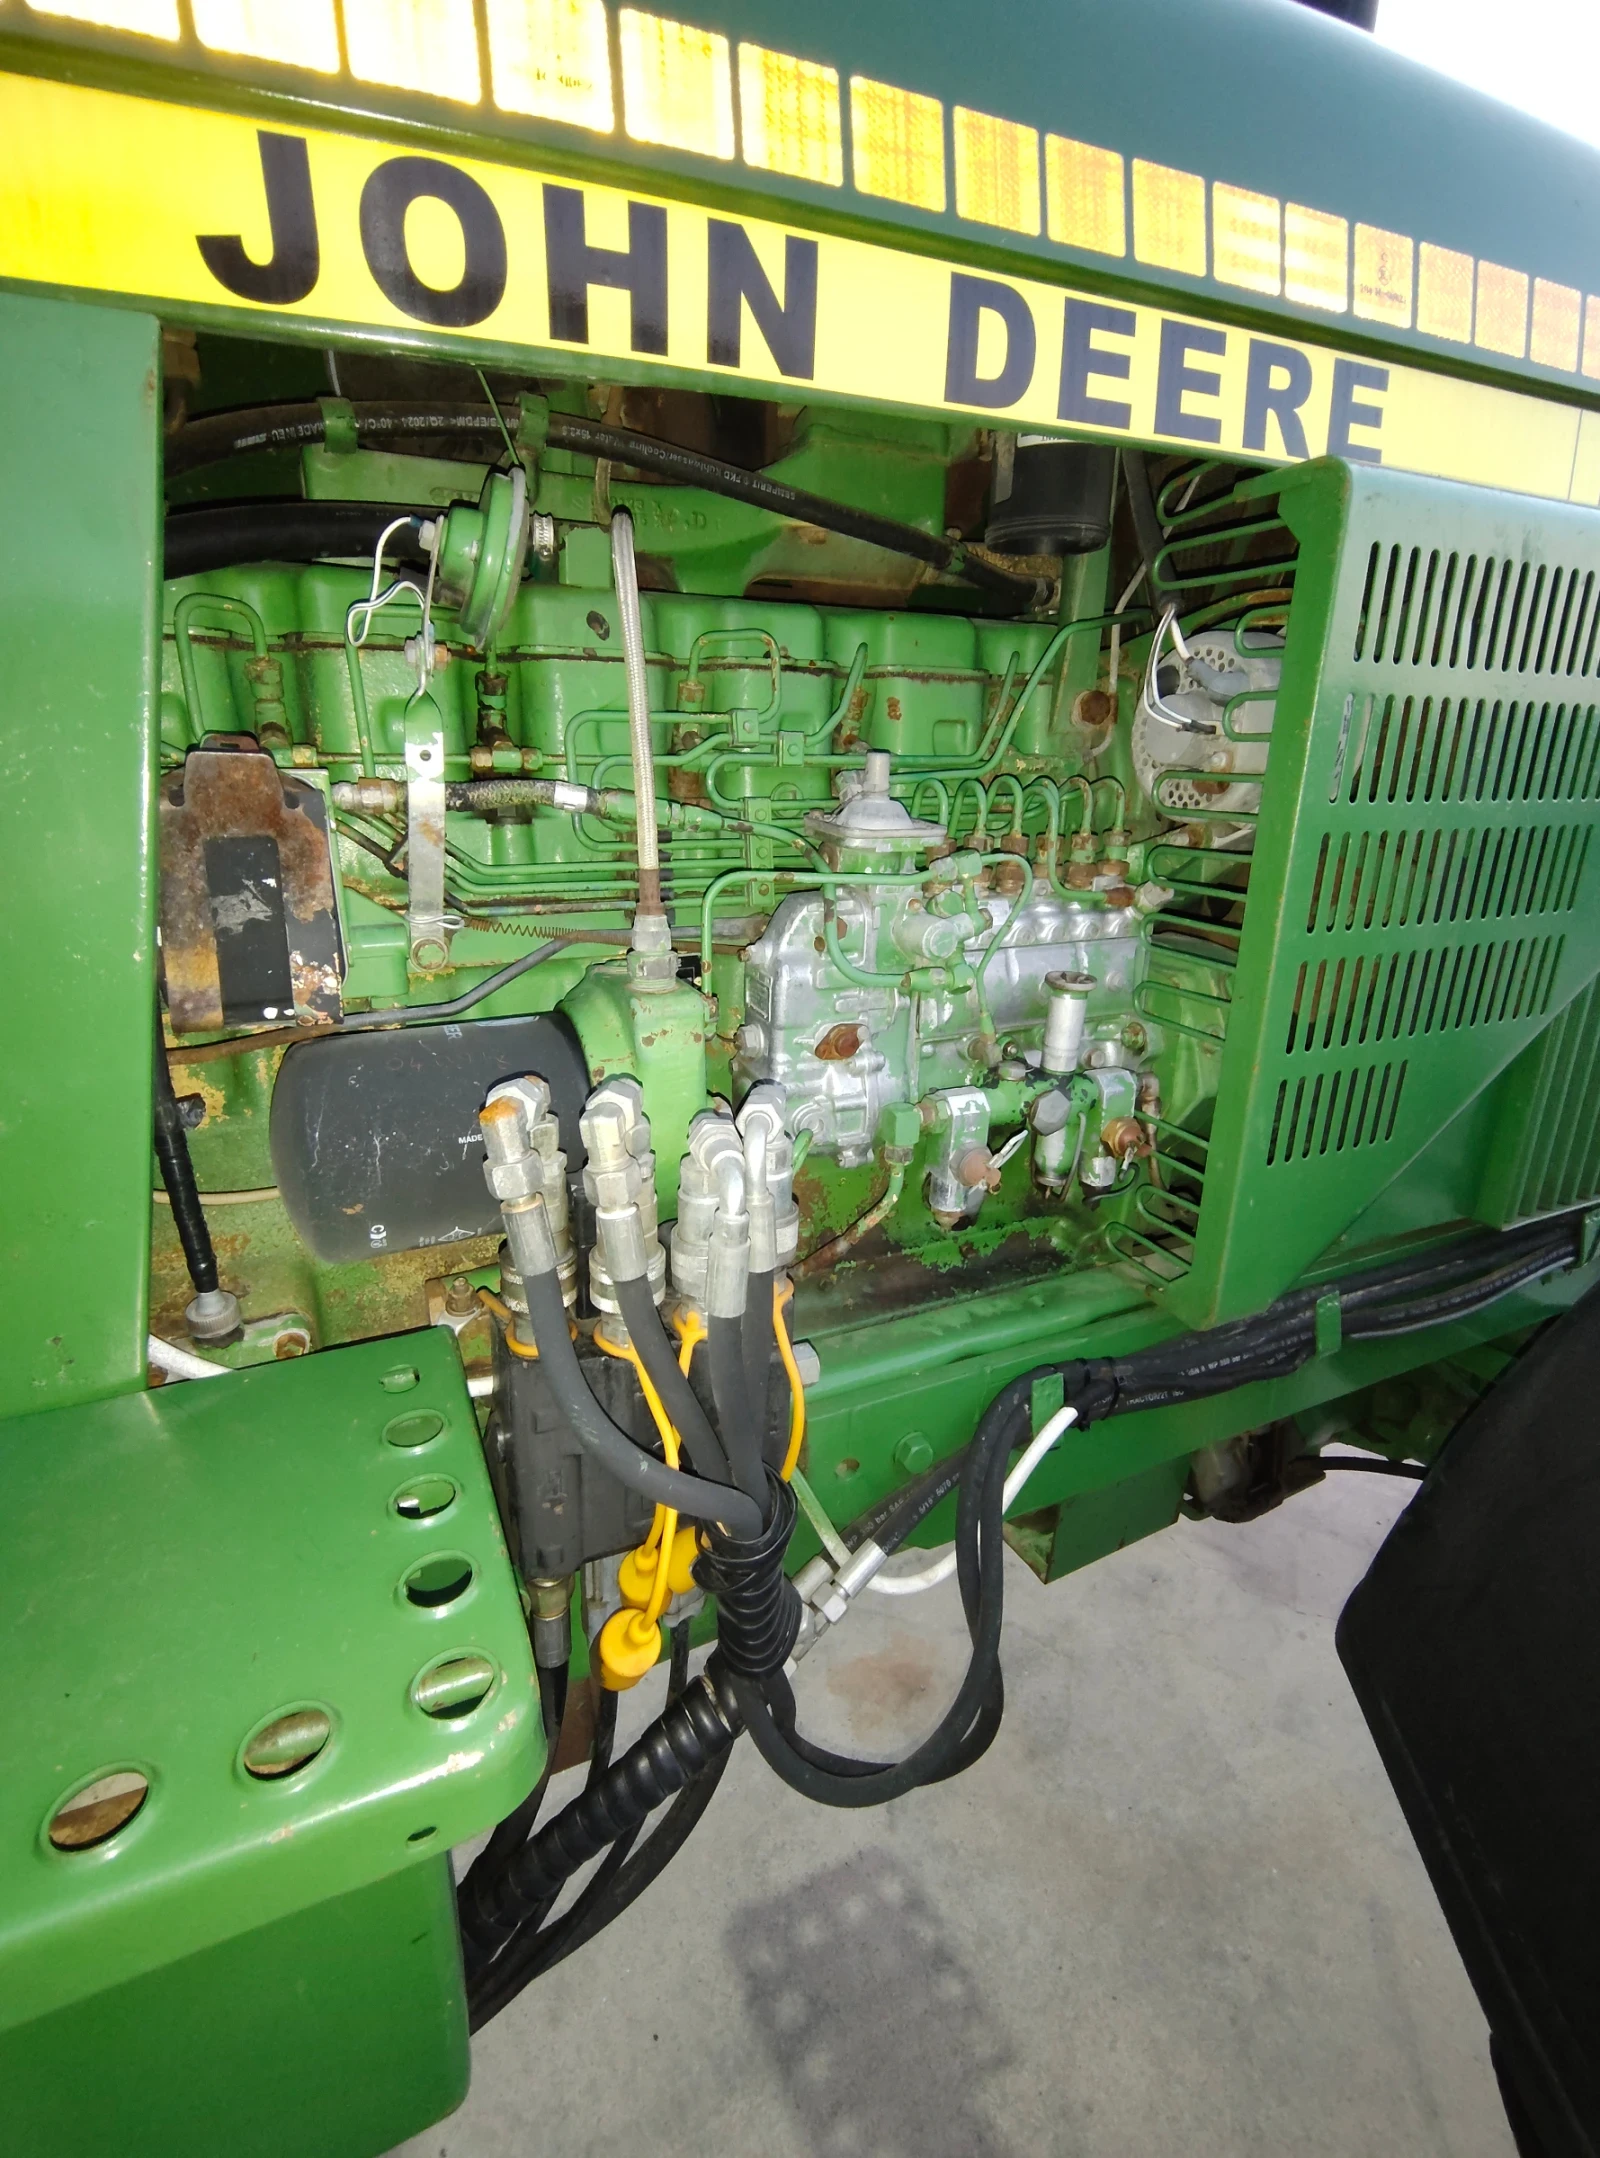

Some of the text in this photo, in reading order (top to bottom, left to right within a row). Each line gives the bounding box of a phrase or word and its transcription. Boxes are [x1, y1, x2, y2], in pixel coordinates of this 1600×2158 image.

[196, 130, 1390, 464] JOHN DEERE
[458, 1133, 484, 1145] MADE
[874, 1511, 888, 1525] bar
